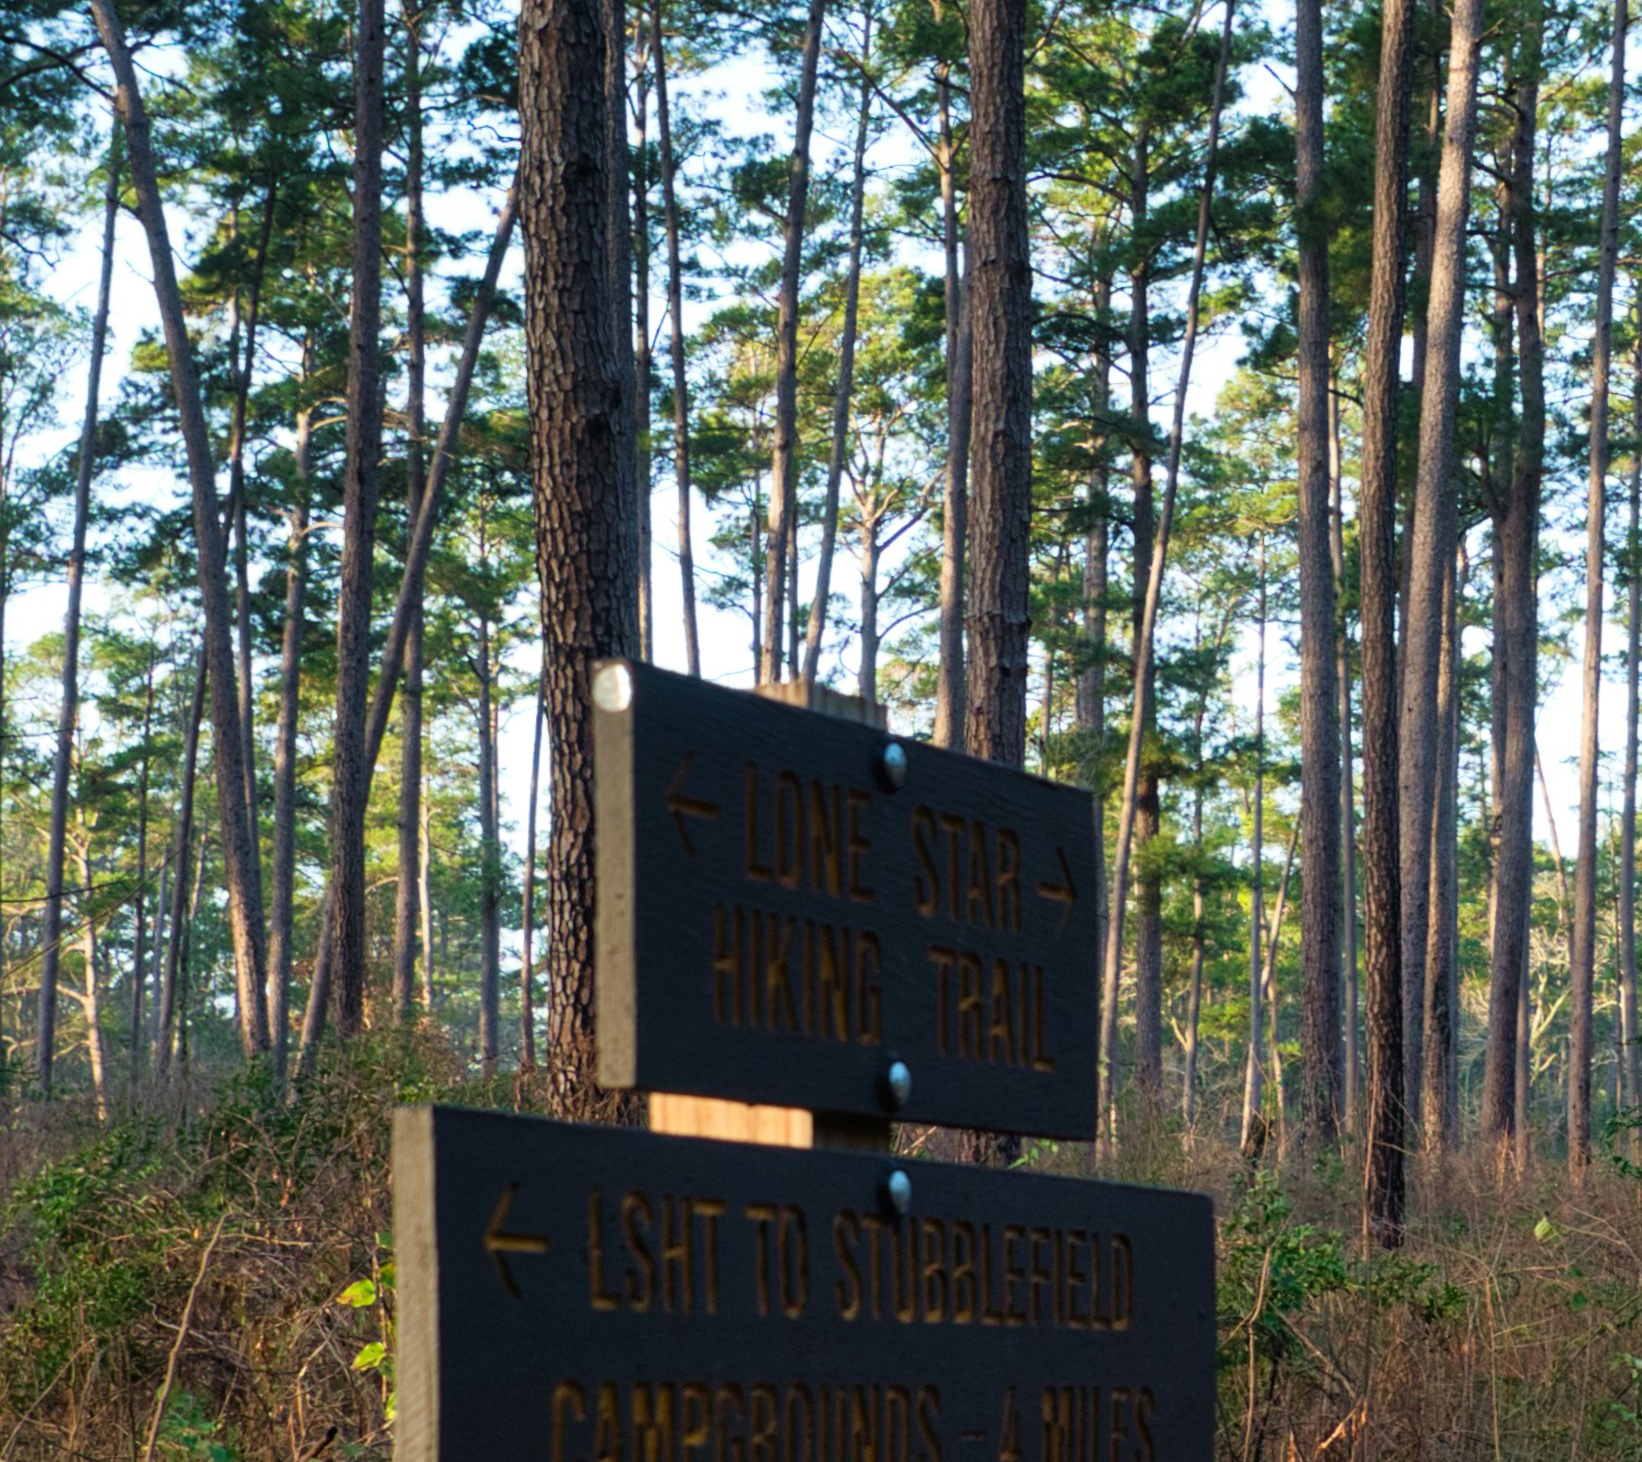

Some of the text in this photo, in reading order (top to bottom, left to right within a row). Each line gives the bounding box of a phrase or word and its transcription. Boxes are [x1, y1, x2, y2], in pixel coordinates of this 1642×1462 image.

[744, 761, 1022, 934] LONE STAR
[713, 903, 1056, 1072] HIKING TRAIL
[588, 1188, 1135, 1332] LSHT TO STUBBLEFIELD
